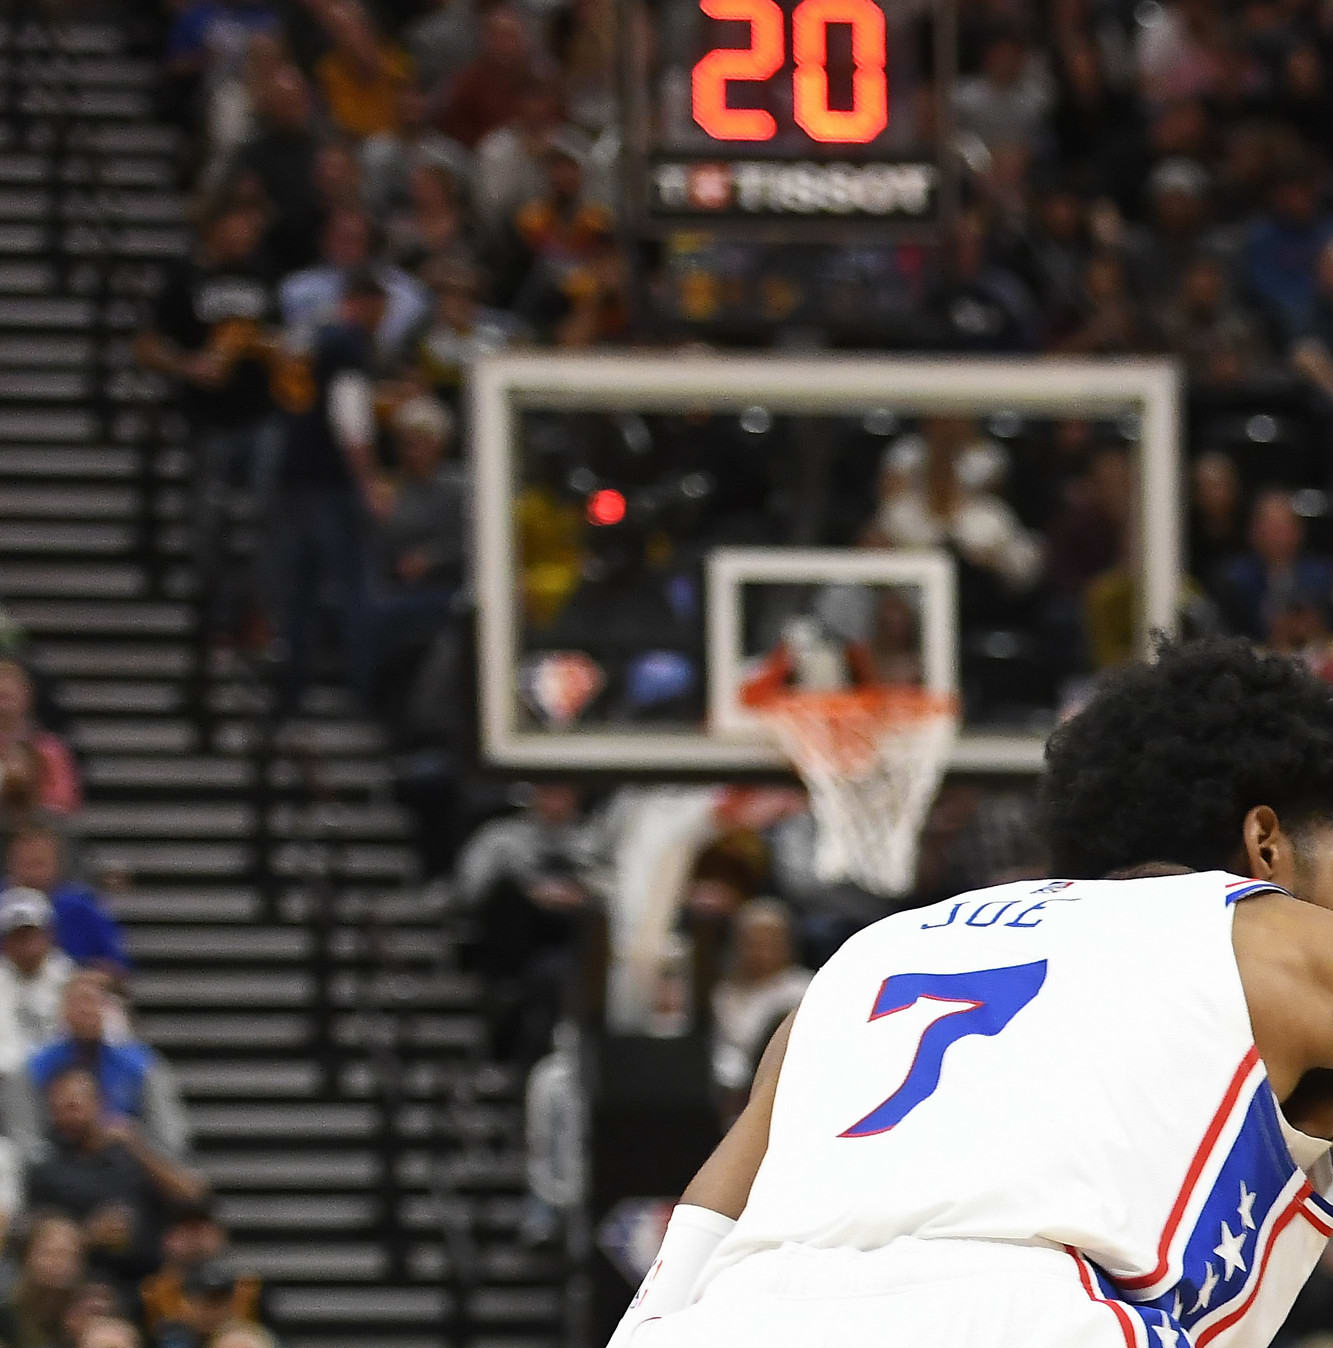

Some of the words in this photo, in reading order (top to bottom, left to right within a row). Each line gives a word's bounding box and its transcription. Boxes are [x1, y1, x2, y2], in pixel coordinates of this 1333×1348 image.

[692, 0, 889, 144] 20
[920, 898, 1082, 929] JOE
[836, 958, 1048, 1138] 7
